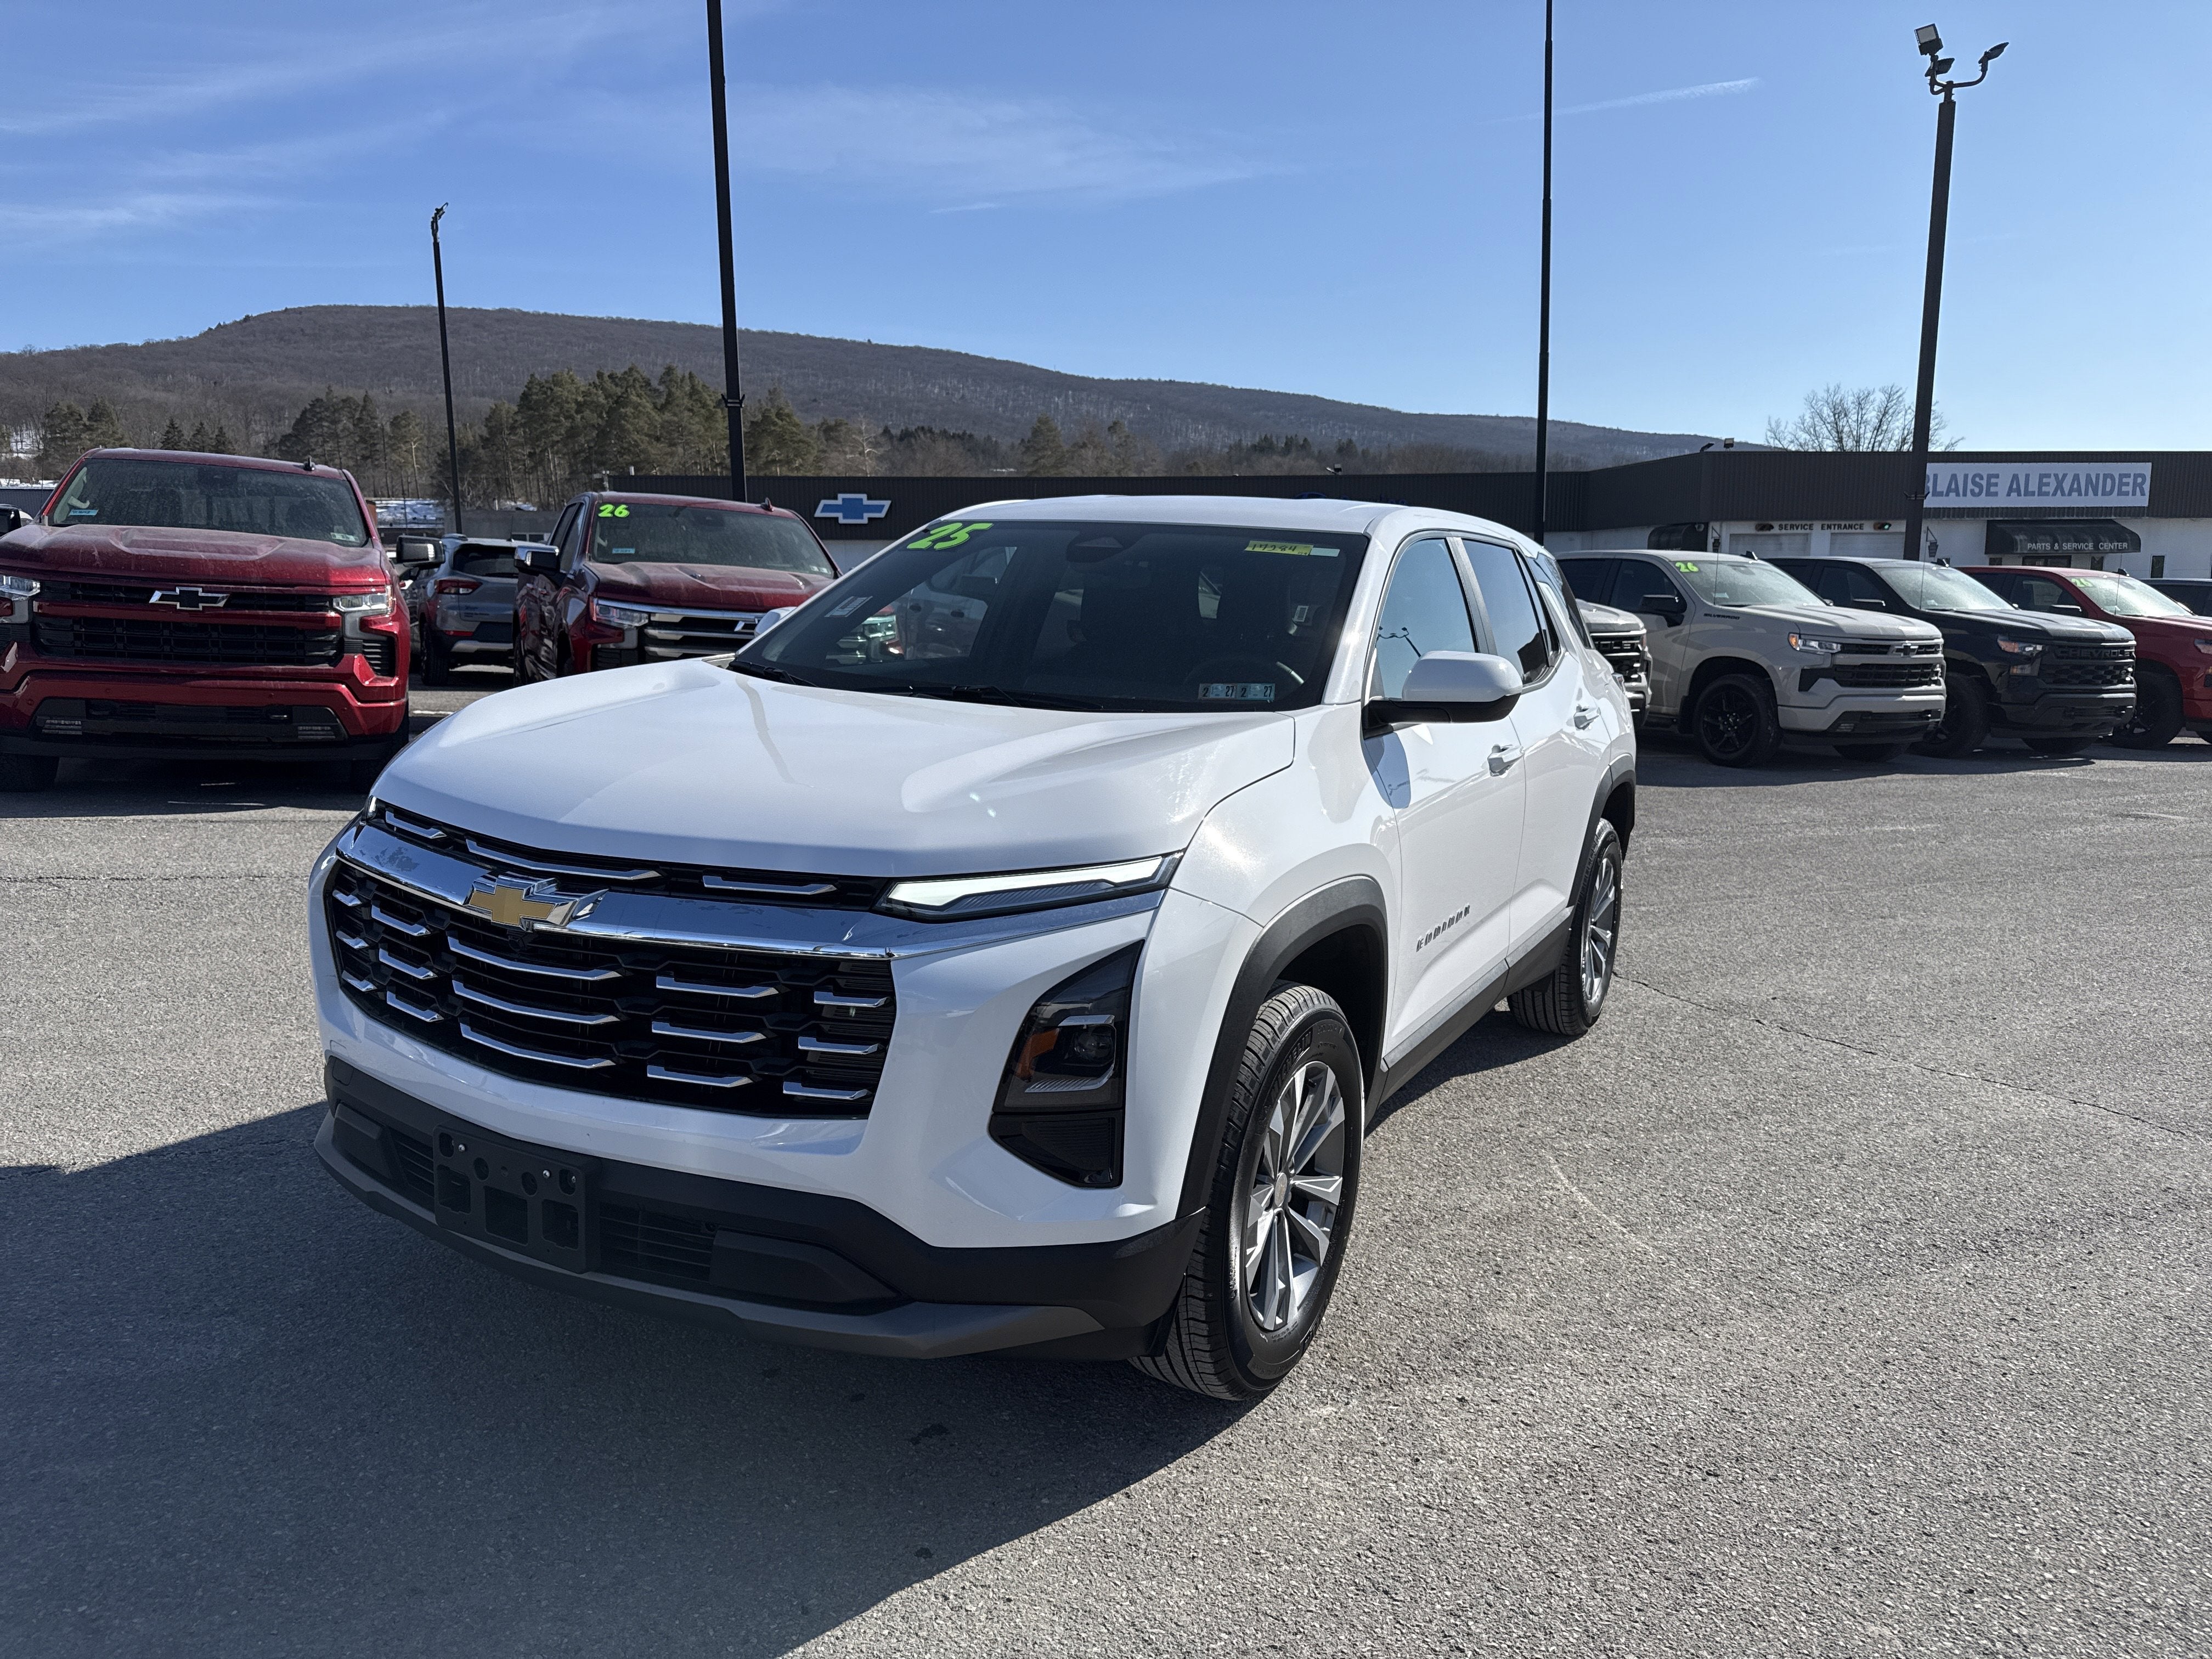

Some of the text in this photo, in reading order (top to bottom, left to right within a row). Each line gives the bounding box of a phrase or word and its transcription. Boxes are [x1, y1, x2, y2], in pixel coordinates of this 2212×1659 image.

[2006, 472, 2147, 498] ALEXANDER
[598, 503, 630, 518] 26
[906, 522, 994, 550] 25
[1675, 562, 1699, 572] 26
[2071, 578, 2094, 587] 26
[1202, 686, 1234, 697] 2 27
[1240, 686, 1272, 697] 2 27
